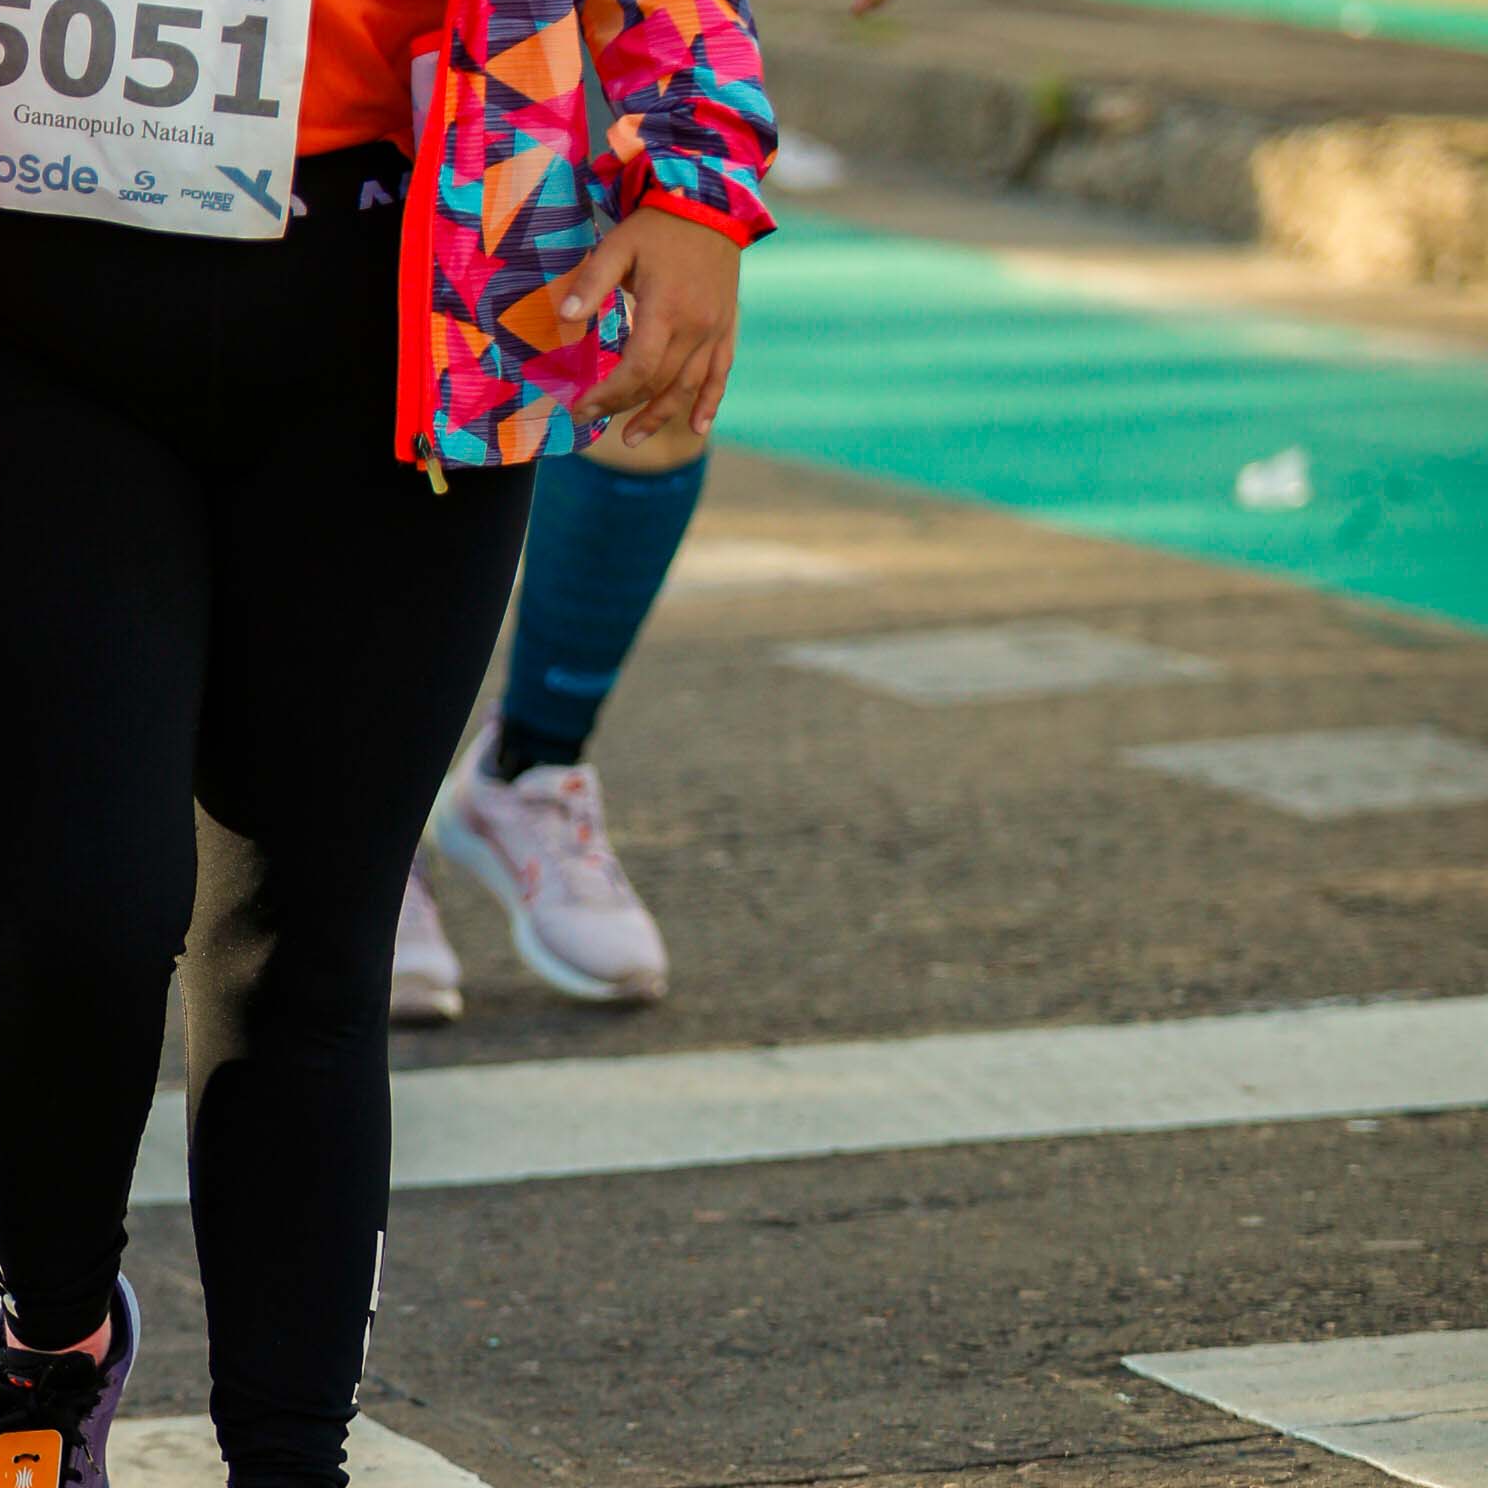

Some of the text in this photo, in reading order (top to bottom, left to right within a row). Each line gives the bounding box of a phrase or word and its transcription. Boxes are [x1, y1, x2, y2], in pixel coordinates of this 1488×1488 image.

[13, 104, 215, 146] Gananopulo Natalia
[180, 188, 234, 203] POWER
